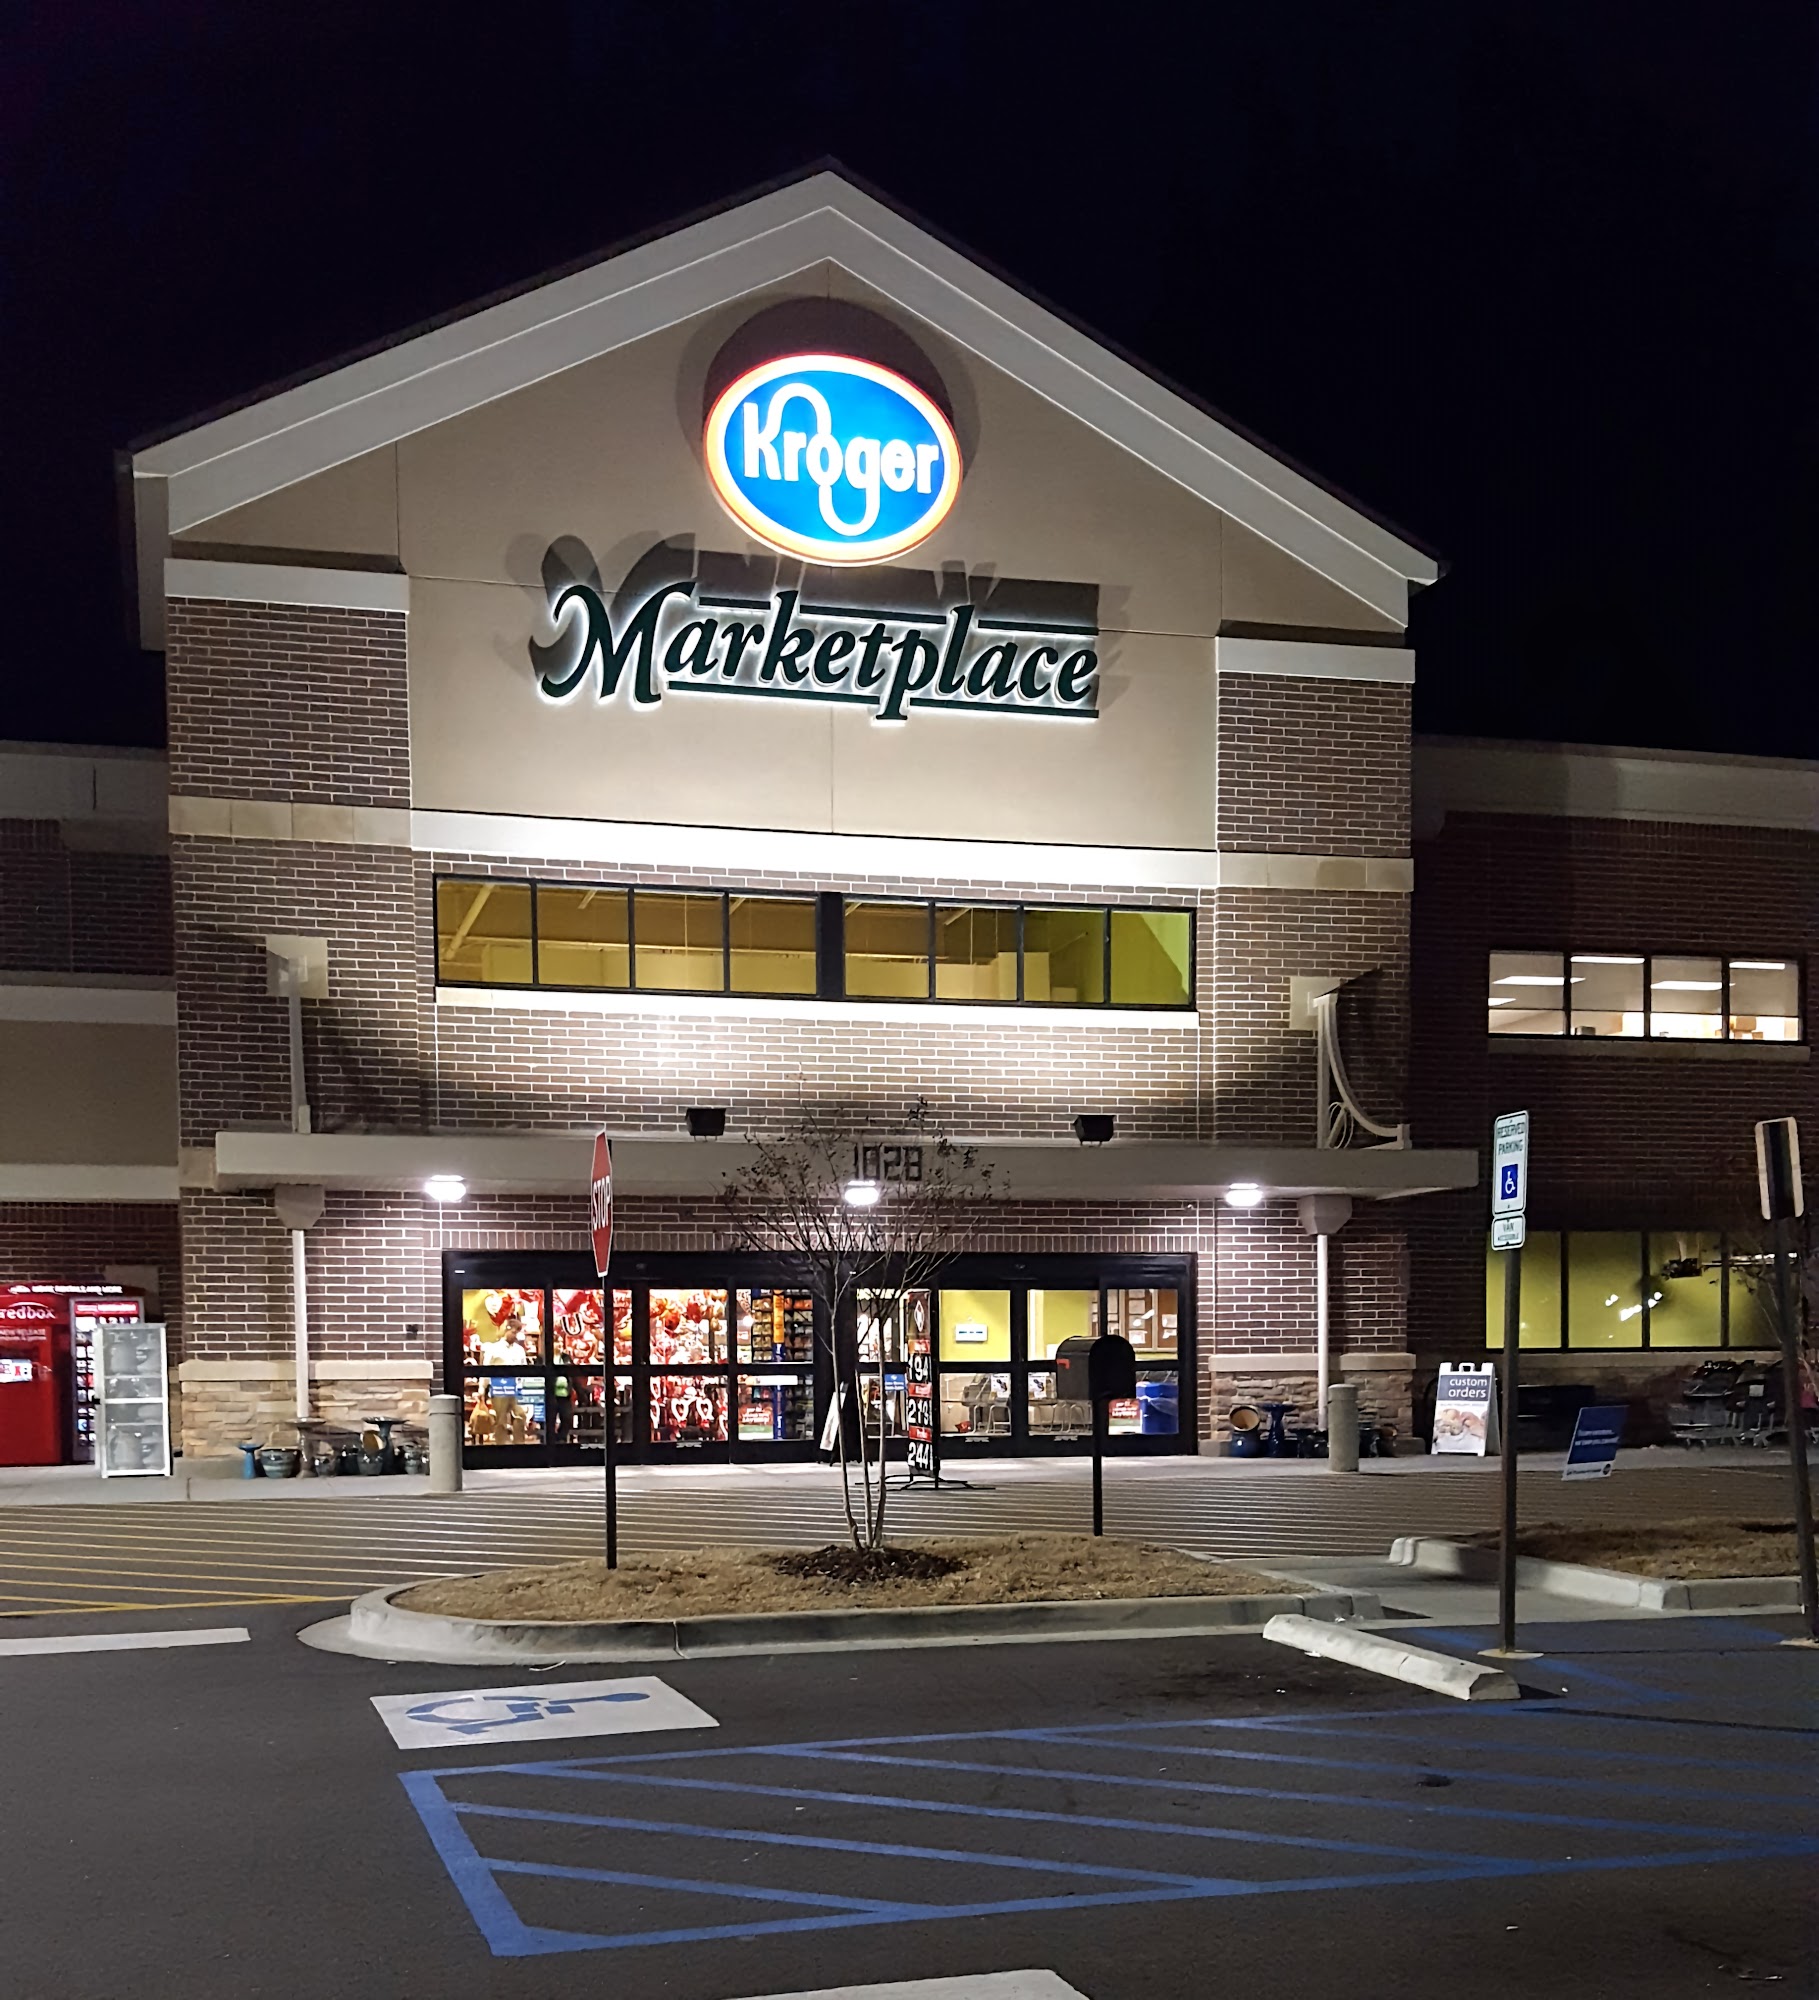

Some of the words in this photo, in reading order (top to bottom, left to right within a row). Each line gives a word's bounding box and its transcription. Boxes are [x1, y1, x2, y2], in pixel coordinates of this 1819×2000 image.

[743, 383, 940, 537] Kroger
[541, 584, 1098, 721] Marketplace
[1497, 1122, 1525, 1139] RESERVED
[1498, 1140, 1523, 1155] PARKING
[854, 1145, 922, 1181] 1028
[592, 1175, 611, 1231] STOP
[1448, 1387, 1486, 1398] orders
[1450, 1378, 1487, 1386] custom
